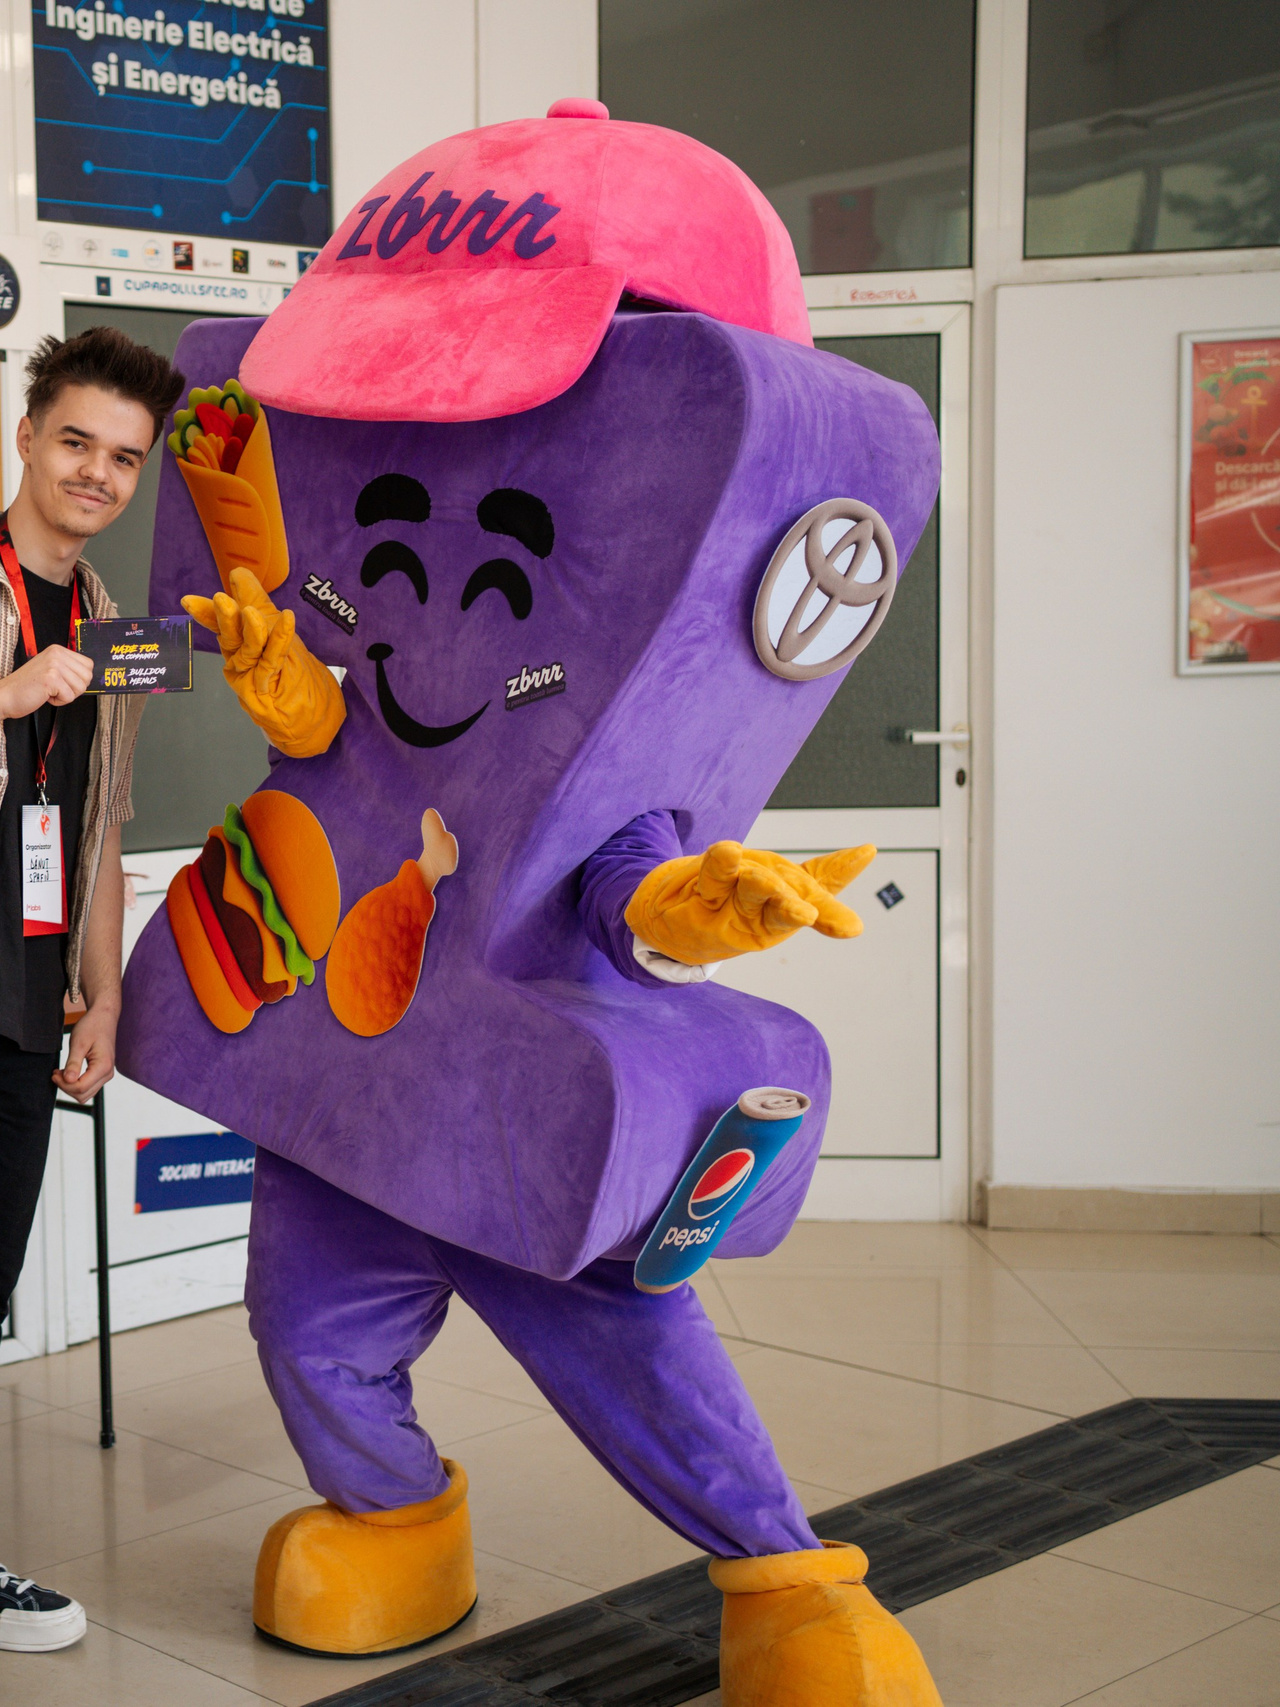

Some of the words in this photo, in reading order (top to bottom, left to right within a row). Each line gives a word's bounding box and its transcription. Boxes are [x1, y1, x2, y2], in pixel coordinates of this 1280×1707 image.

[45, 0, 184, 46] Inginerie
[188, 20, 314, 67] Electrică
[92, 52, 119, 96] și
[124, 60, 282, 109] Energetică
[336, 171, 562, 261] zbrrr
[304, 574, 357, 623] zbrrr
[110, 644, 138, 655] MADE
[139, 642, 159, 653] FOR
[105, 671, 127, 686] 50%
[127, 667, 167, 677] BULLDOG
[129, 676, 157, 685] MENUS
[507, 664, 564, 698] zbrrr
[158, 1163, 202, 1182] JOCURI
[659, 1220, 720, 1252] pepsi
